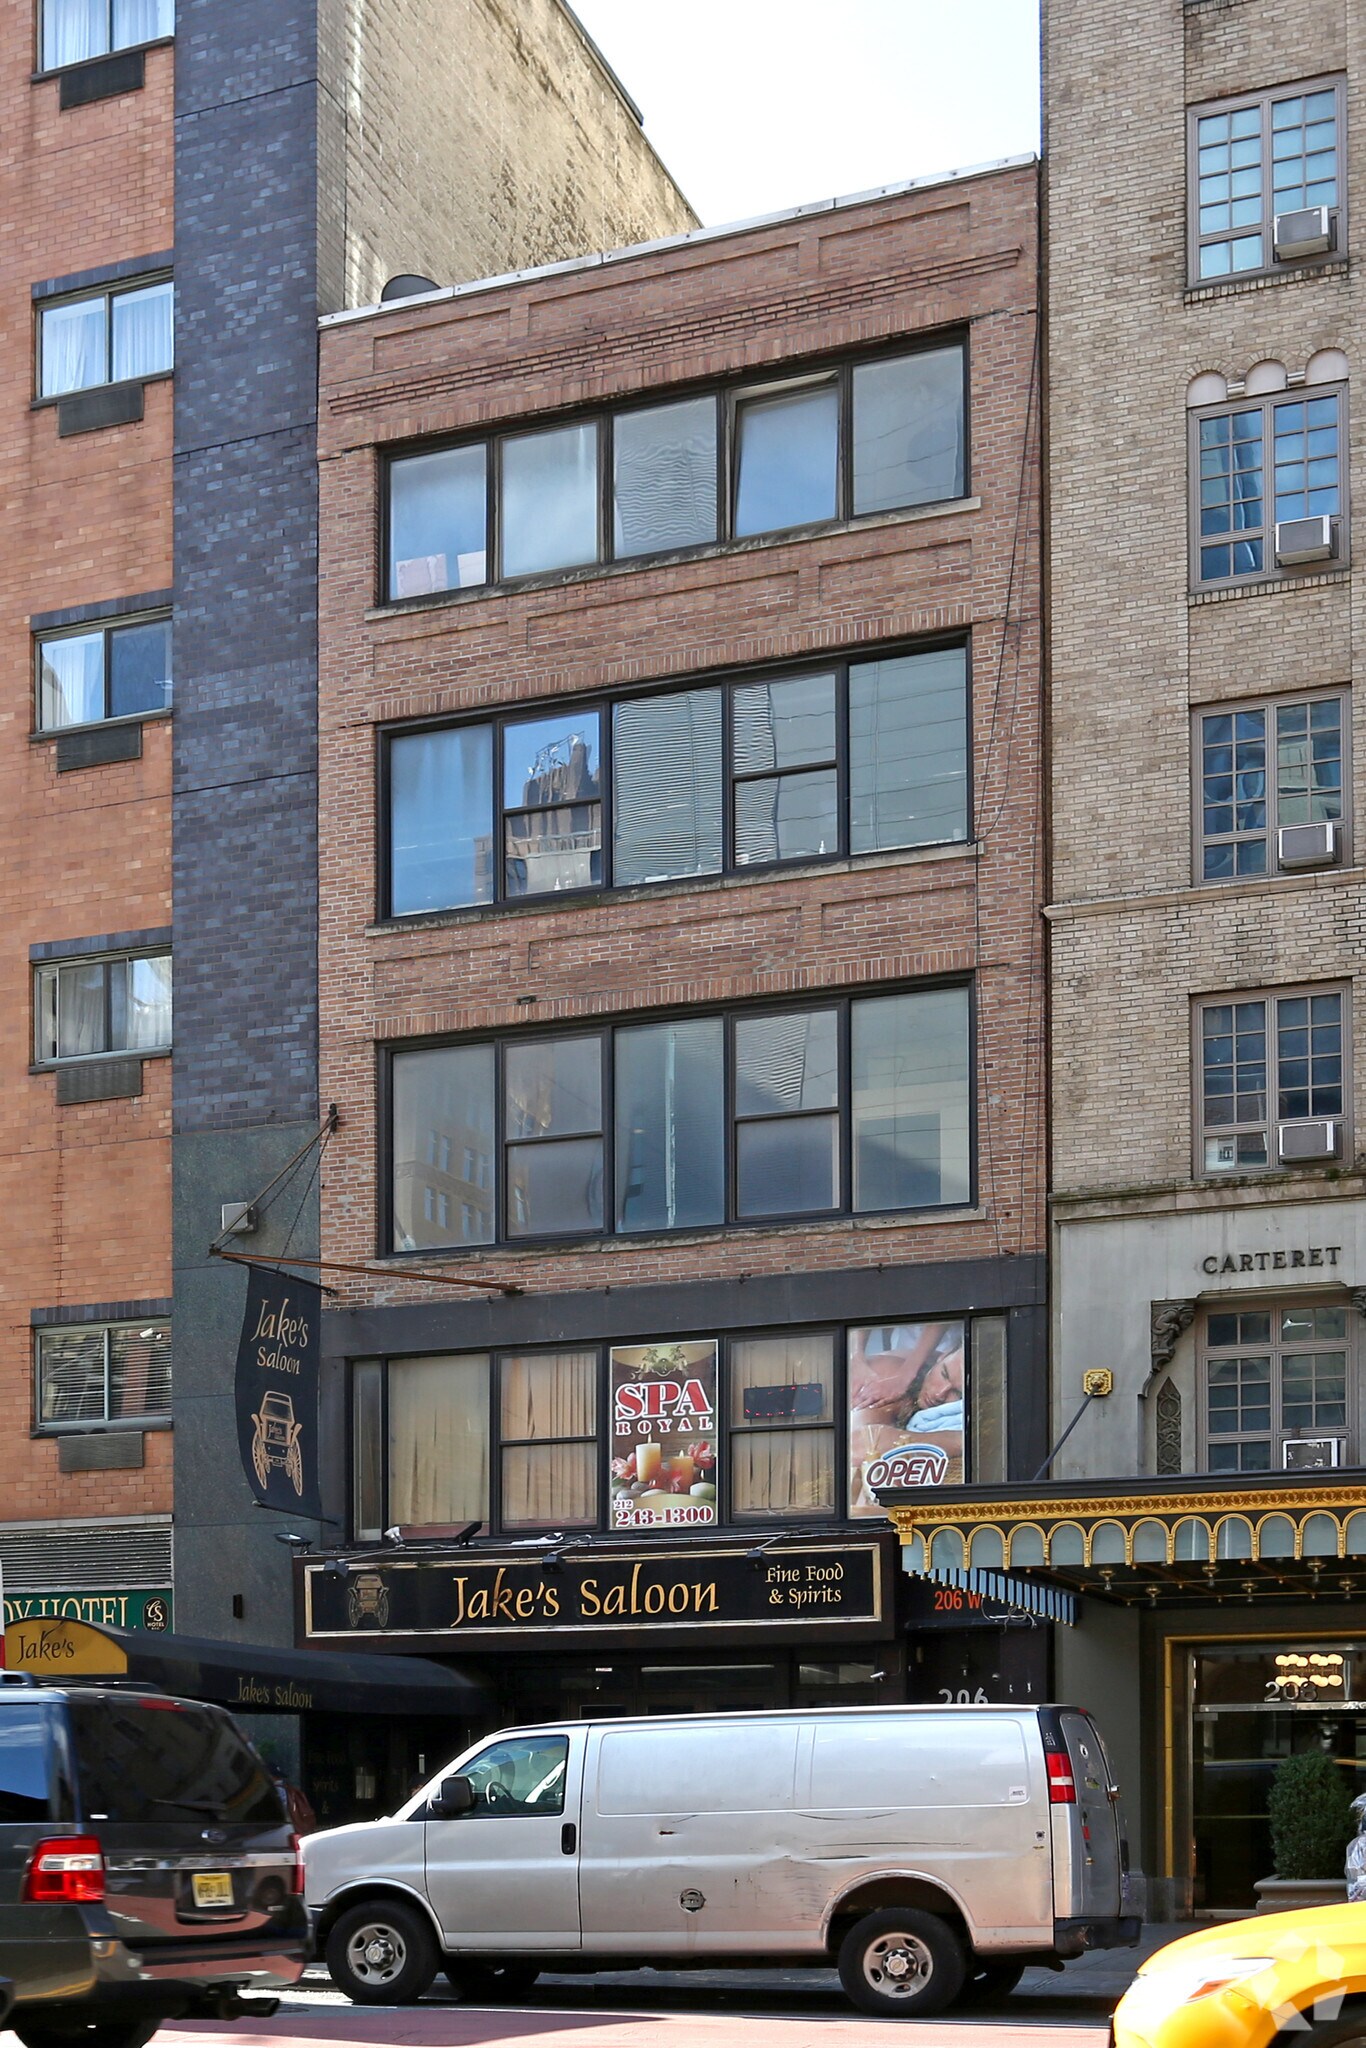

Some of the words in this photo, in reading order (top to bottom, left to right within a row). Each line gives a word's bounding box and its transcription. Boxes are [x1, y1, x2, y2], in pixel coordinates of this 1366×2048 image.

[1202, 1246, 1342, 1275] CARTERET
[250, 1298, 309, 1348] Jake's
[256, 1343, 300, 1375] Saloon
[615, 1379, 714, 1420] SPA
[615, 1416, 713, 1436] ROYAL
[866, 1457, 948, 1488] OPEN
[613, 1500, 633, 1510] 212
[616, 1506, 713, 1527] 243-1300
[765, 1564, 800, 1583] Fine
[805, 1562, 844, 1582] Food
[450, 1567, 560, 1628] Jake's
[579, 1563, 720, 1617] Saloon
[768, 1588, 784, 1604] &
[788, 1584, 842, 1610] Spirits
[934, 1590, 963, 1611] 206
[968, 1592, 981, 1610] W
[16, 1630, 75, 1664] Jake's
[238, 1677, 270, 1704] Jake's
[275, 1681, 313, 1709] Saloon
[938, 1687, 989, 1704] 206
[1264, 1681, 1318, 1702] 208
